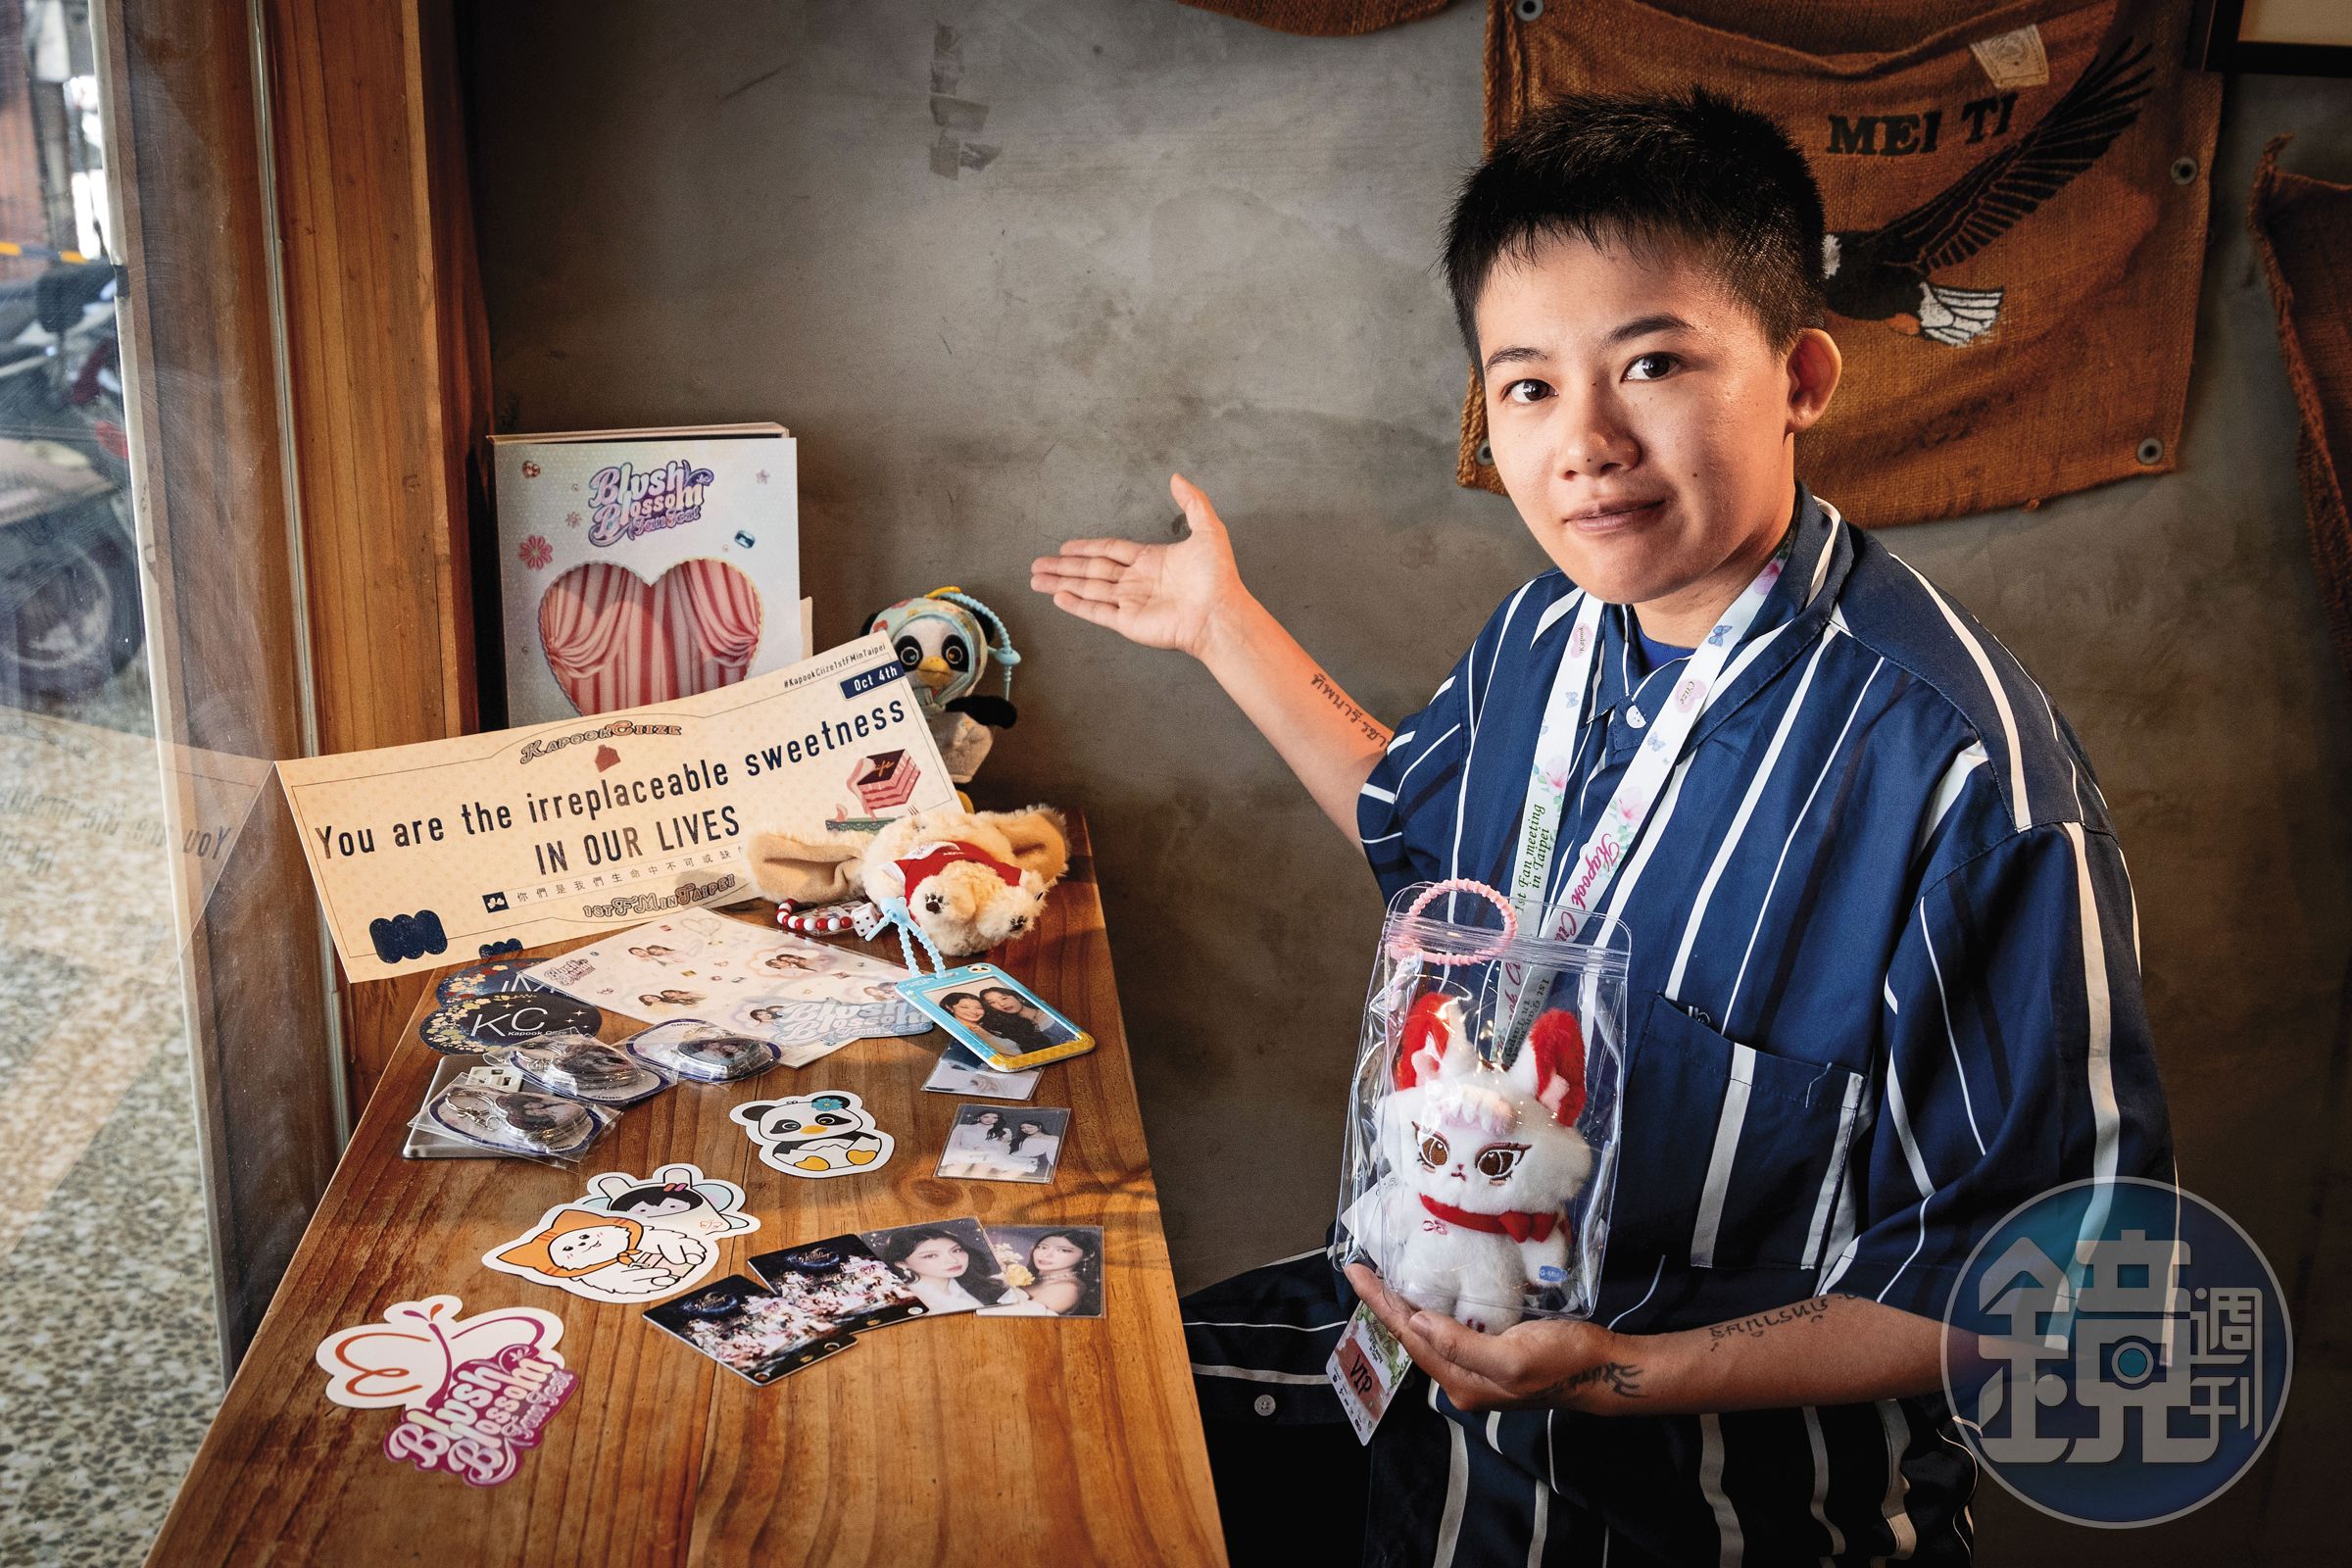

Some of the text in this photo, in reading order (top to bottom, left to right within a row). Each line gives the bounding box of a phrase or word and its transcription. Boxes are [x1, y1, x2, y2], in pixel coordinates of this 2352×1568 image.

[1825, 109, 1943, 157] MEI
[588, 461, 690, 508] Blush
[589, 483, 706, 545] Blossom
[854, 665, 899, 692] Oct 4th
[315, 700, 905, 859] You are the irreplaceable sweetness
[534, 805, 740, 875] IN OUR LIVES
[1515, 803, 1545, 913] 1st Fan meeting
[1529, 828, 1551, 889] in Taipei
[1571, 833, 1620, 911] Kapook
[470, 1006, 549, 1037] KC
[1349, 1352, 1373, 1396] VIP
[388, 1365, 504, 1468] Blush
[447, 1357, 556, 1482] Blossom
